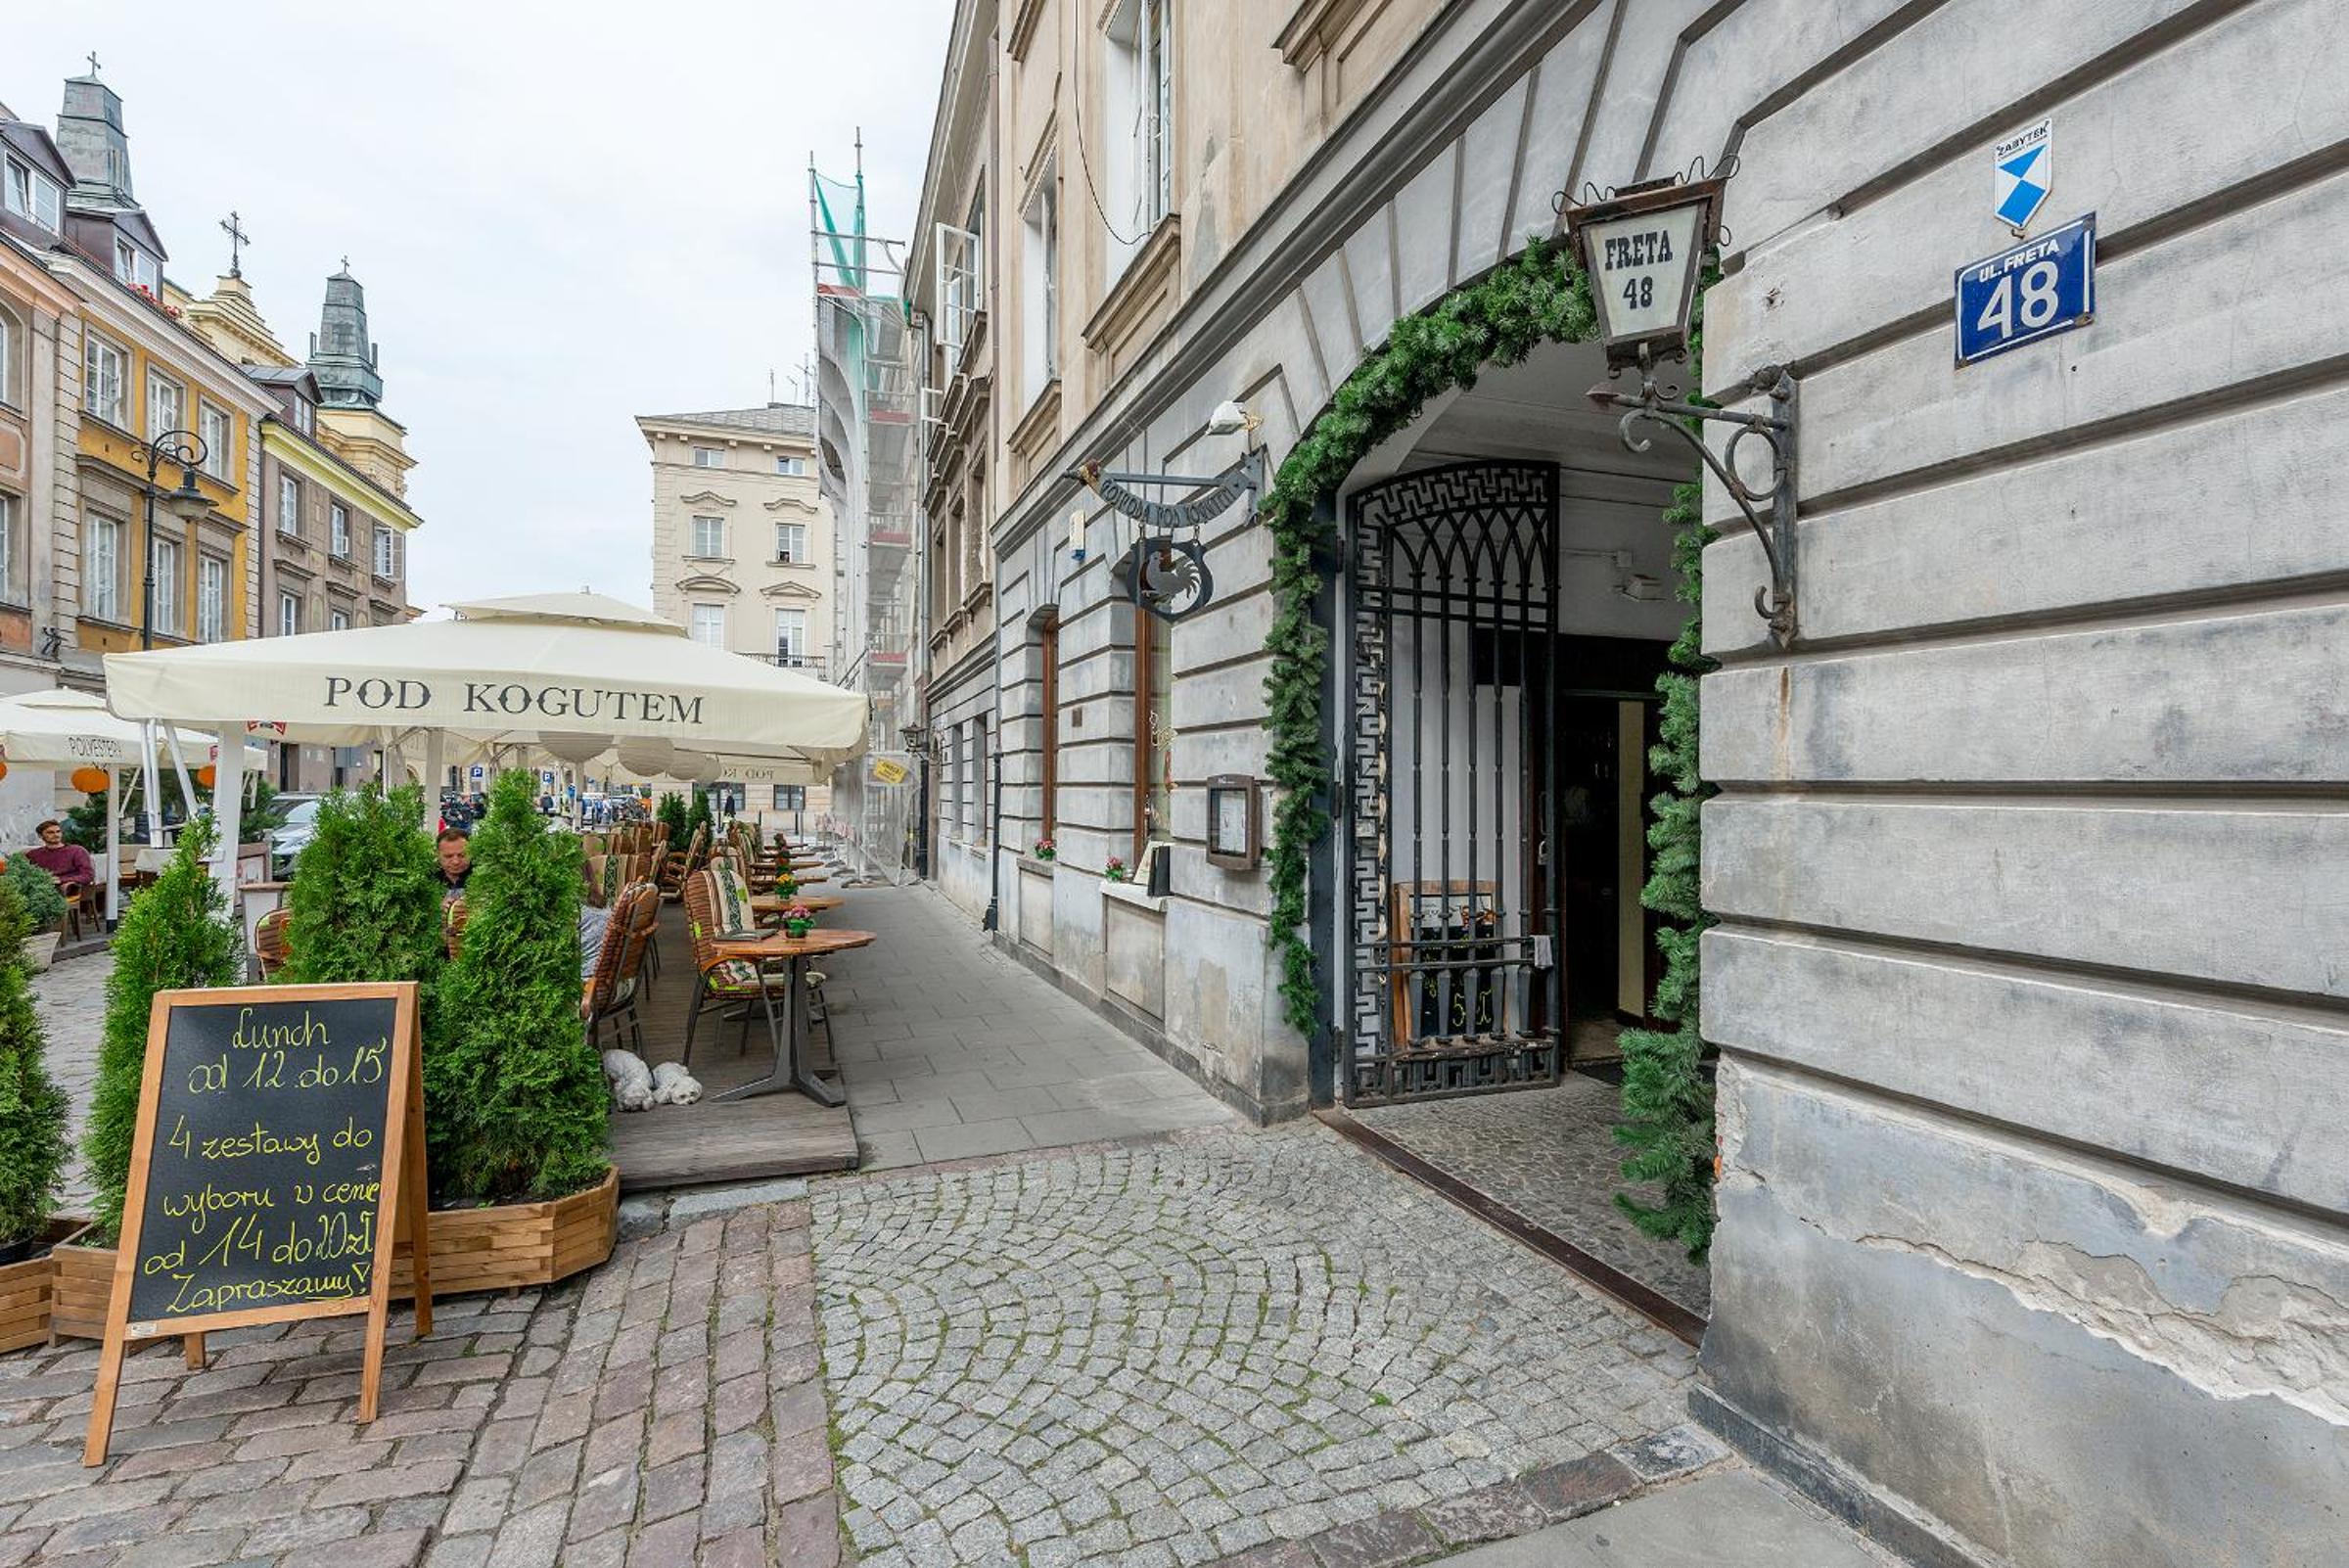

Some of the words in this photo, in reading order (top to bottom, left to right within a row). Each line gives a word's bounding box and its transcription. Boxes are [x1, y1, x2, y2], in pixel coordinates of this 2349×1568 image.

[1996, 119, 2050, 157] ZABYTEK
[1604, 230, 1674, 271] FRETA
[1979, 264, 2003, 283] UL.
[2004, 239, 2060, 274] FRETA
[1623, 276, 1654, 310] 48
[1976, 260, 2059, 340] 48
[323, 676, 433, 711] POD
[462, 682, 706, 725] KOGUTEM
[232, 1007, 331, 1049] Lunch
[188, 1053, 228, 1093] od
[243, 1050, 287, 1088] 12
[299, 1053, 340, 1088] do
[344, 1037, 388, 1084] 15
[168, 1115, 191, 1159] 4
[202, 1122, 321, 1165] zestawy
[333, 1116, 373, 1148] do
[163, 1183, 275, 1234] wyboru
[322, 1176, 381, 1204] cenie
[145, 1240, 185, 1274] od
[199, 1213, 264, 1267] 14
[272, 1221, 313, 1265] do
[165, 1262, 372, 1313] Zapraszamy!
